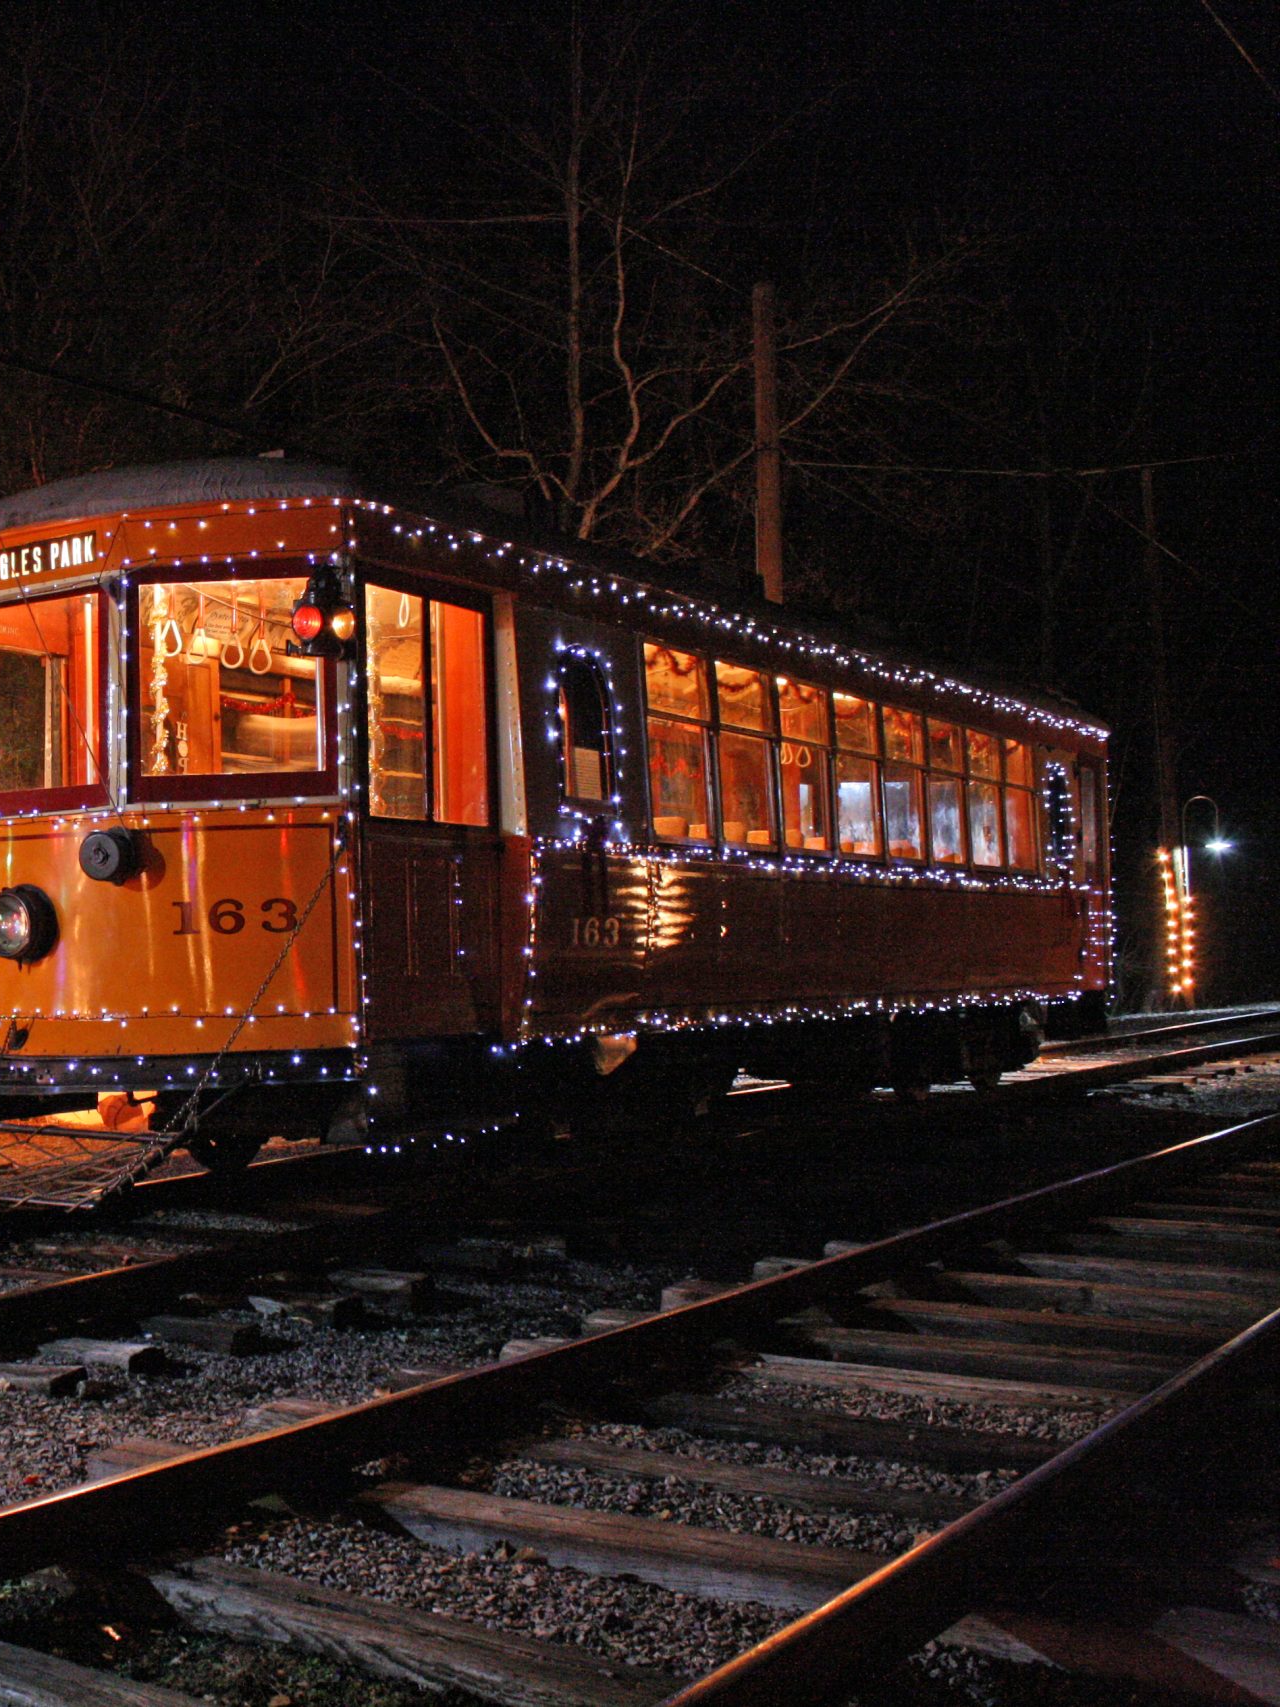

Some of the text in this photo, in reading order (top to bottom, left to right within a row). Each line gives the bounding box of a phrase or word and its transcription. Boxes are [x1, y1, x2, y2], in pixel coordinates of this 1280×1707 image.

[49, 535, 95, 570] PARK
[171, 898, 299, 935] 163
[571, 917, 620, 947] 163
